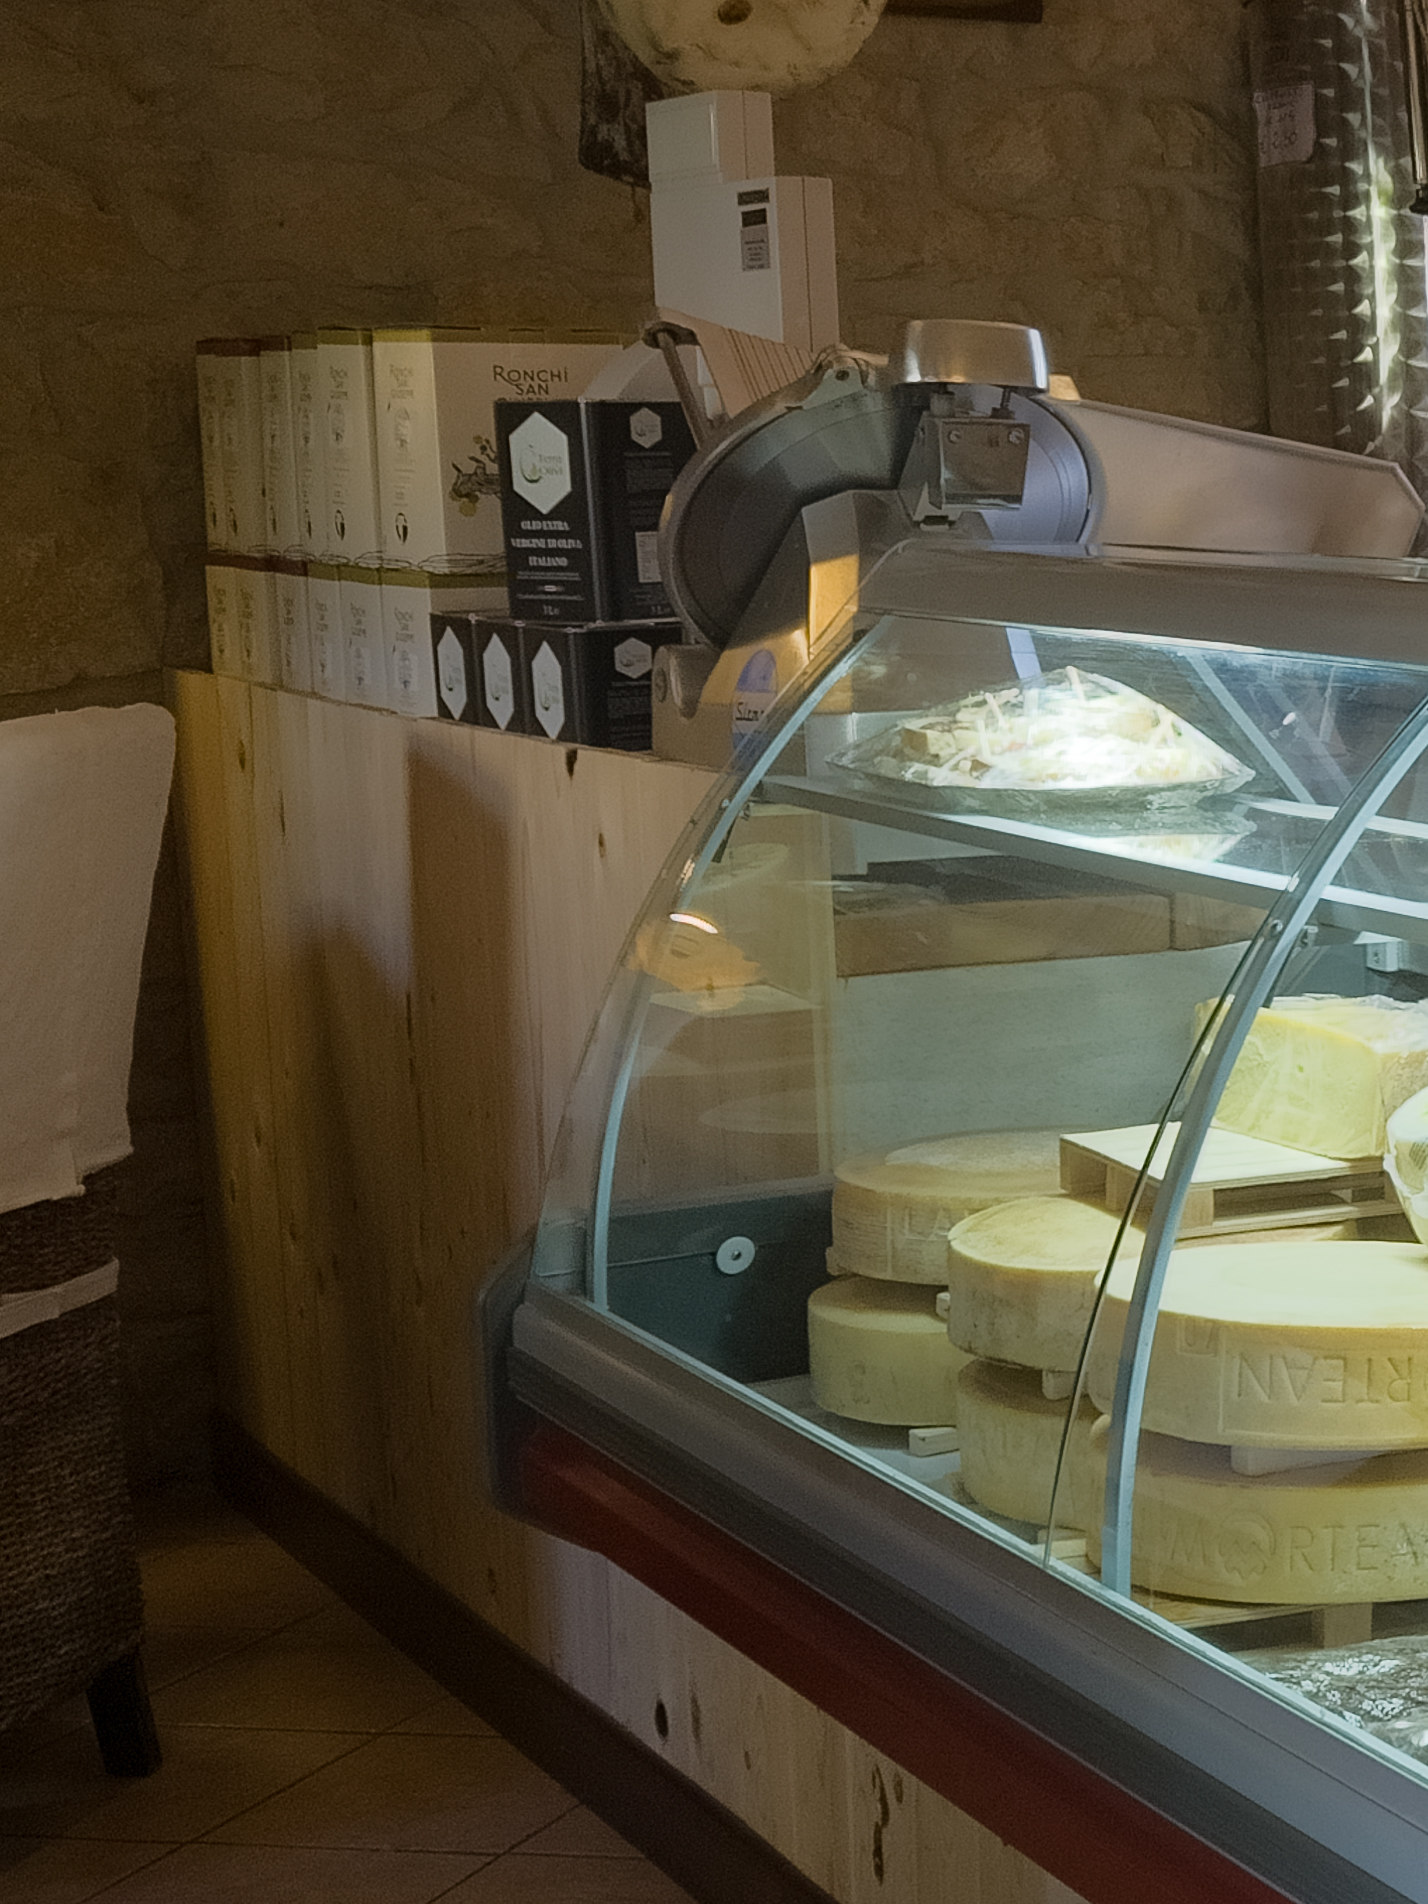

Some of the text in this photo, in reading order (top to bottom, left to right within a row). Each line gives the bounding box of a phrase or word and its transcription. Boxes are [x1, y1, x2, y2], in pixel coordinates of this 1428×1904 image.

[493, 365, 568, 388] RONCHI
[515, 383, 549, 395] SAN
[543, 520, 570, 531] EXTRA
[528, 556, 569, 567] ITALIANO
